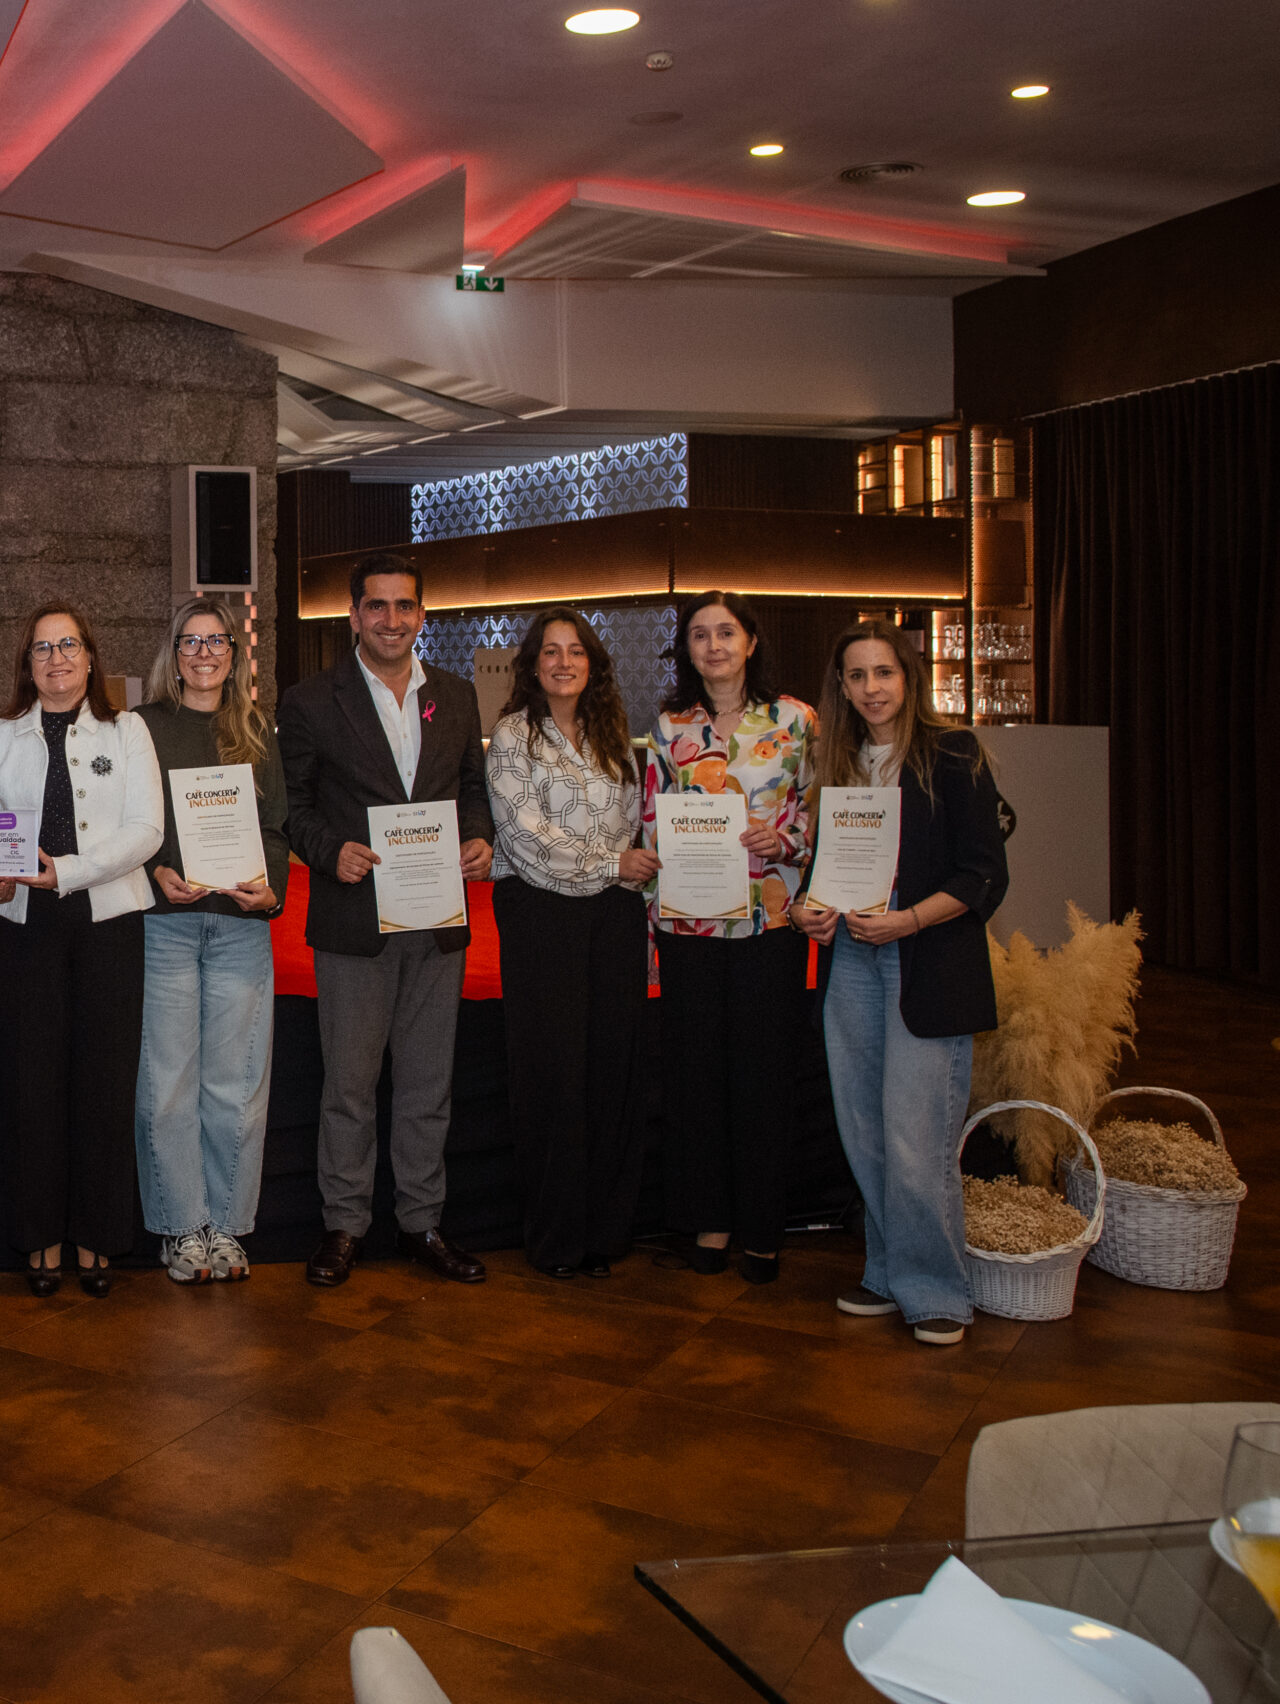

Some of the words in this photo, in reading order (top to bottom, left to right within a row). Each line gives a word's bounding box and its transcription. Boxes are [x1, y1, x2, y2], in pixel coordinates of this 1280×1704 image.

[189, 796, 237, 809] INCLUSIVO
[674, 825, 727, 834] INCLUSIVO
[834, 819, 882, 829] INCLUSIVO
[388, 834, 439, 847] INCLUSIVO
